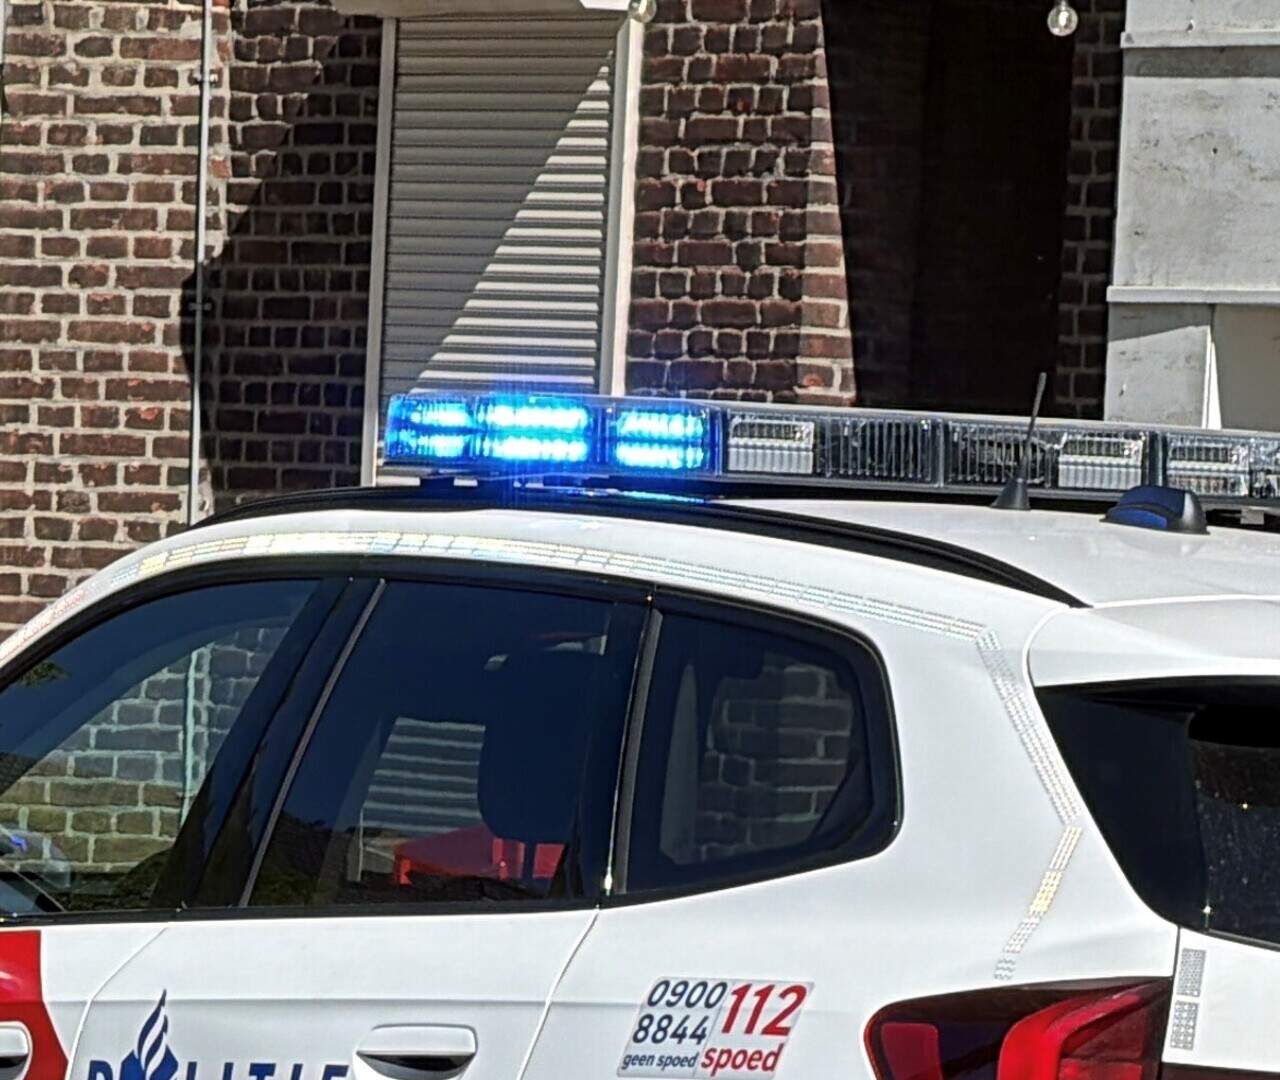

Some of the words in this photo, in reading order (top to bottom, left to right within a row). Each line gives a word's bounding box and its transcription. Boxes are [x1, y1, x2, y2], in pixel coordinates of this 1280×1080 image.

[646, 979, 728, 1009] 0900
[721, 983, 807, 1036] 112
[632, 1013, 709, 1045] 8844
[621, 1053, 655, 1070] geen
[656, 1052, 699, 1071] spoed
[701, 1043, 785, 1077] spoed
